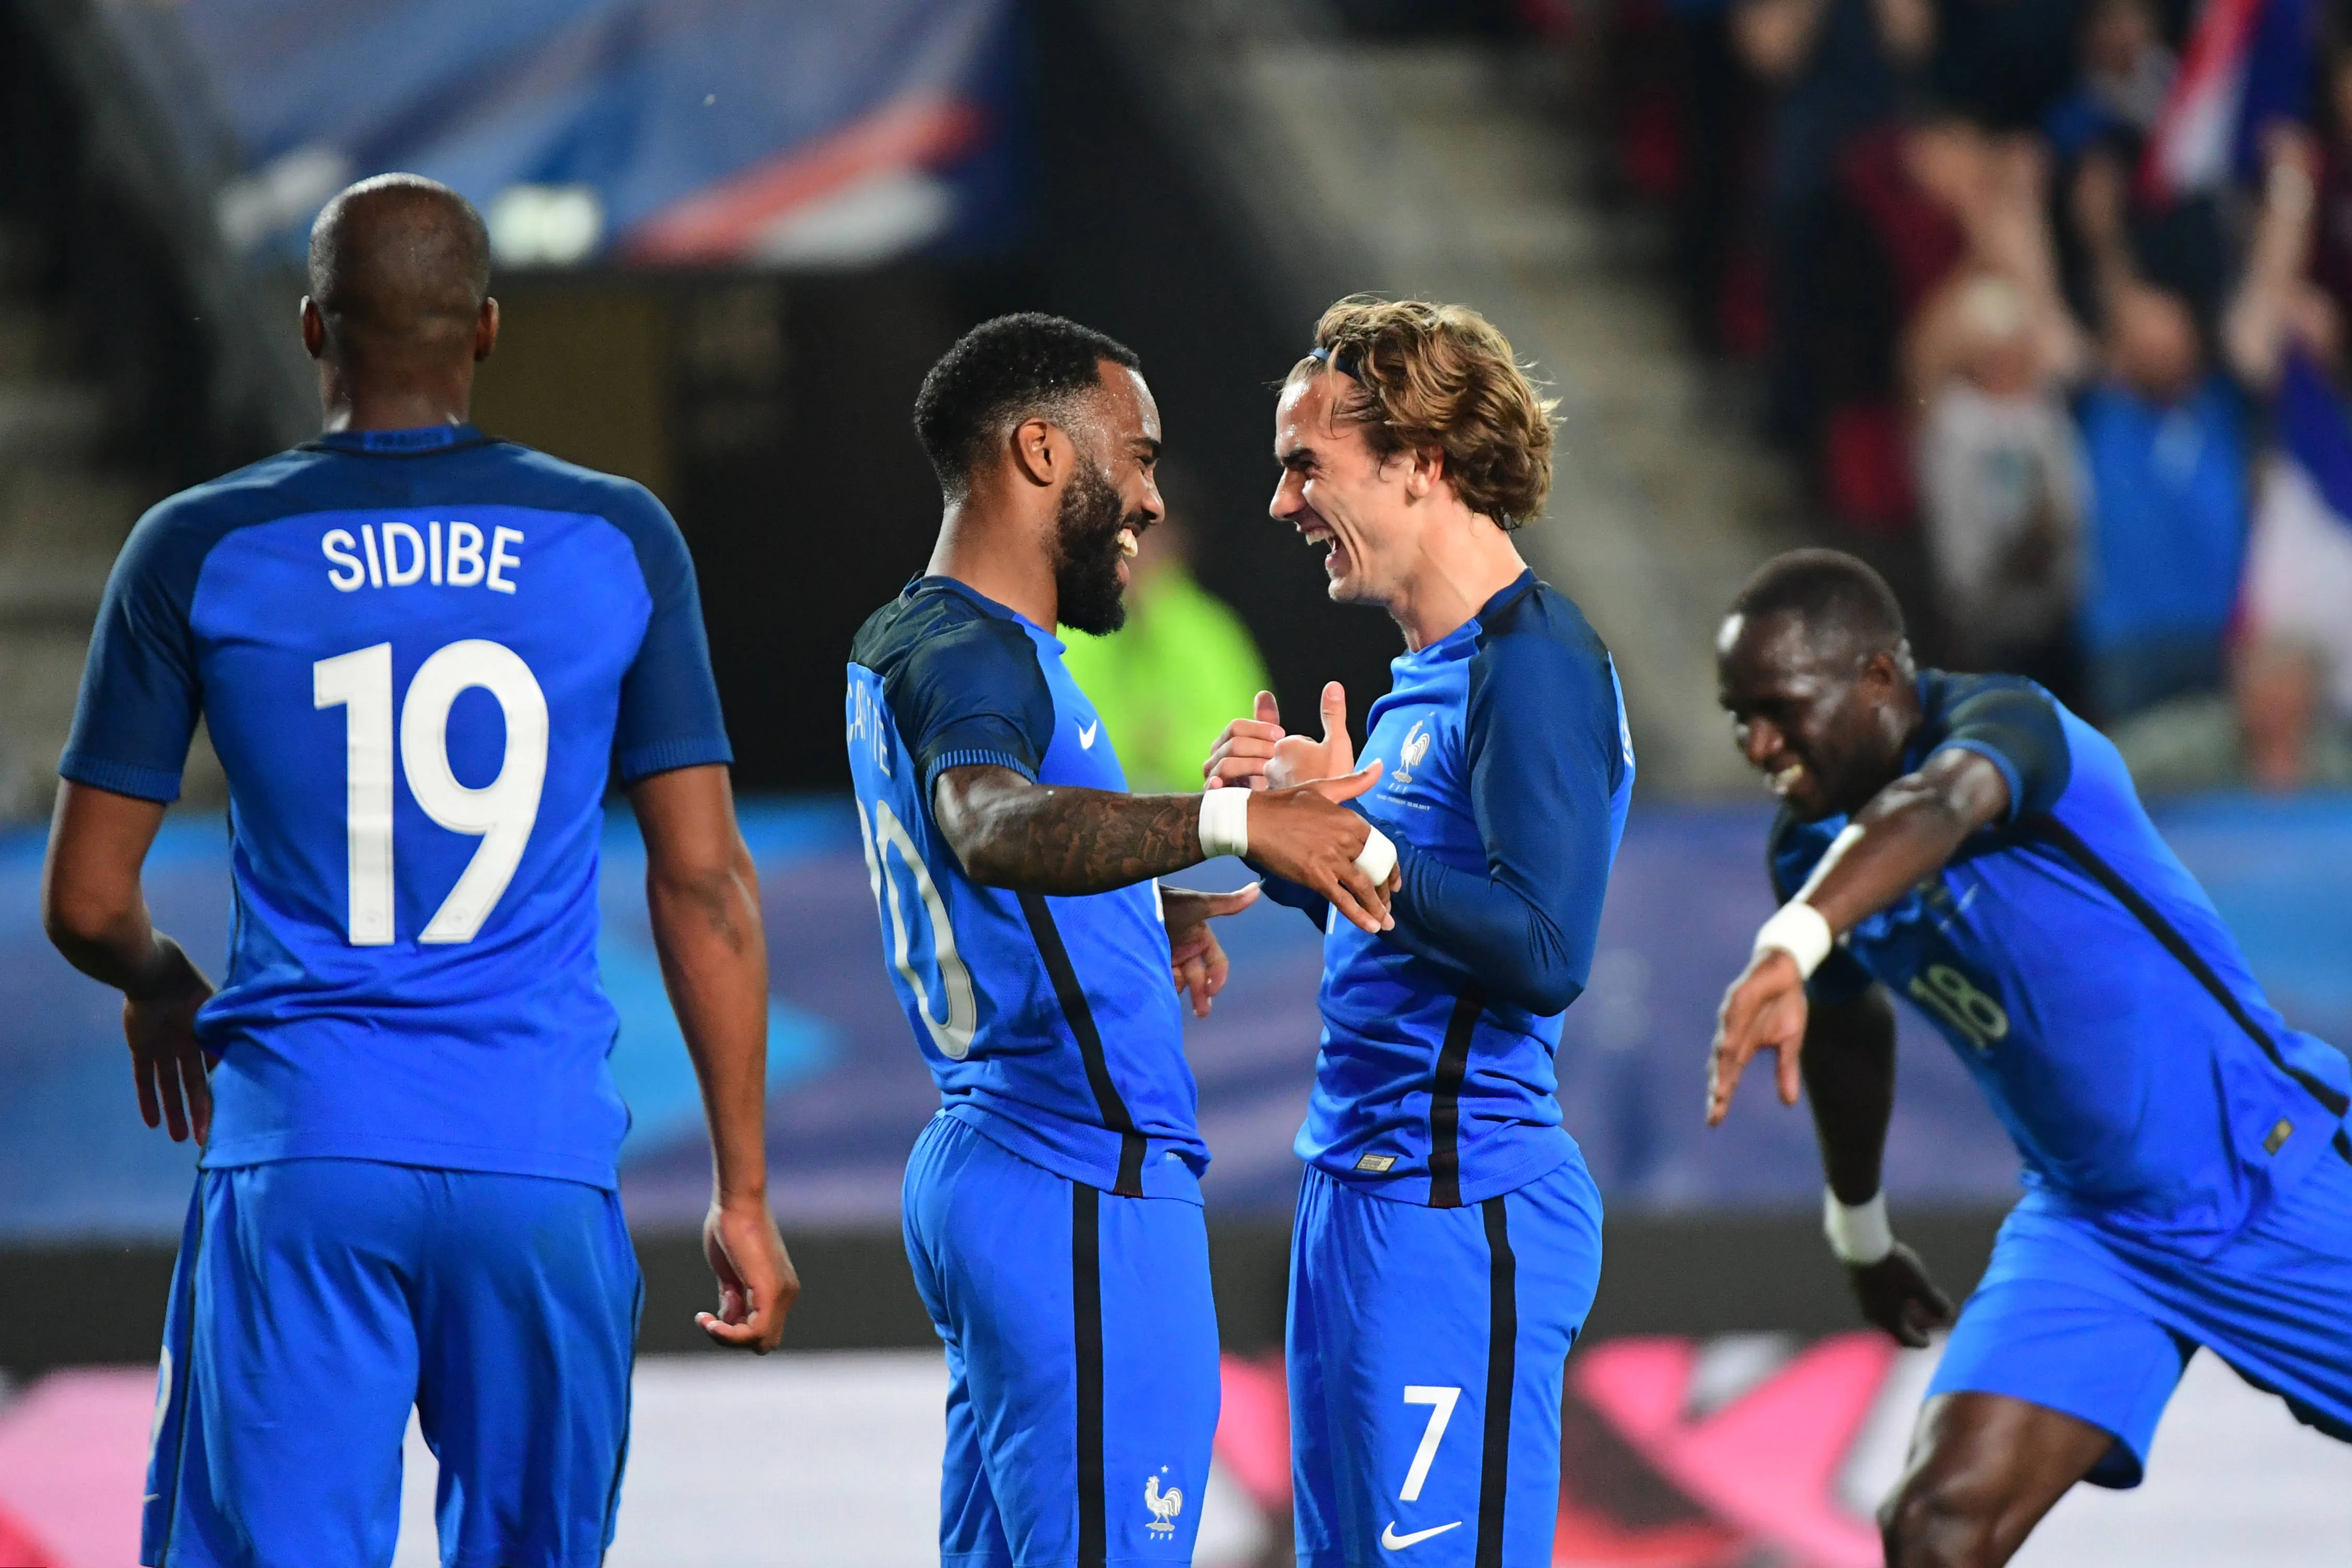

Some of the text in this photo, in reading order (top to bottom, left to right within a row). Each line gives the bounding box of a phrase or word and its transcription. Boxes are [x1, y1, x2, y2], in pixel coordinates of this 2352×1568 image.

[321, 521, 524, 595] SIDIBE
[313, 638, 550, 946] 19
[1909, 964, 2009, 1049] 18
[1399, 1385, 1461, 1501] 7
